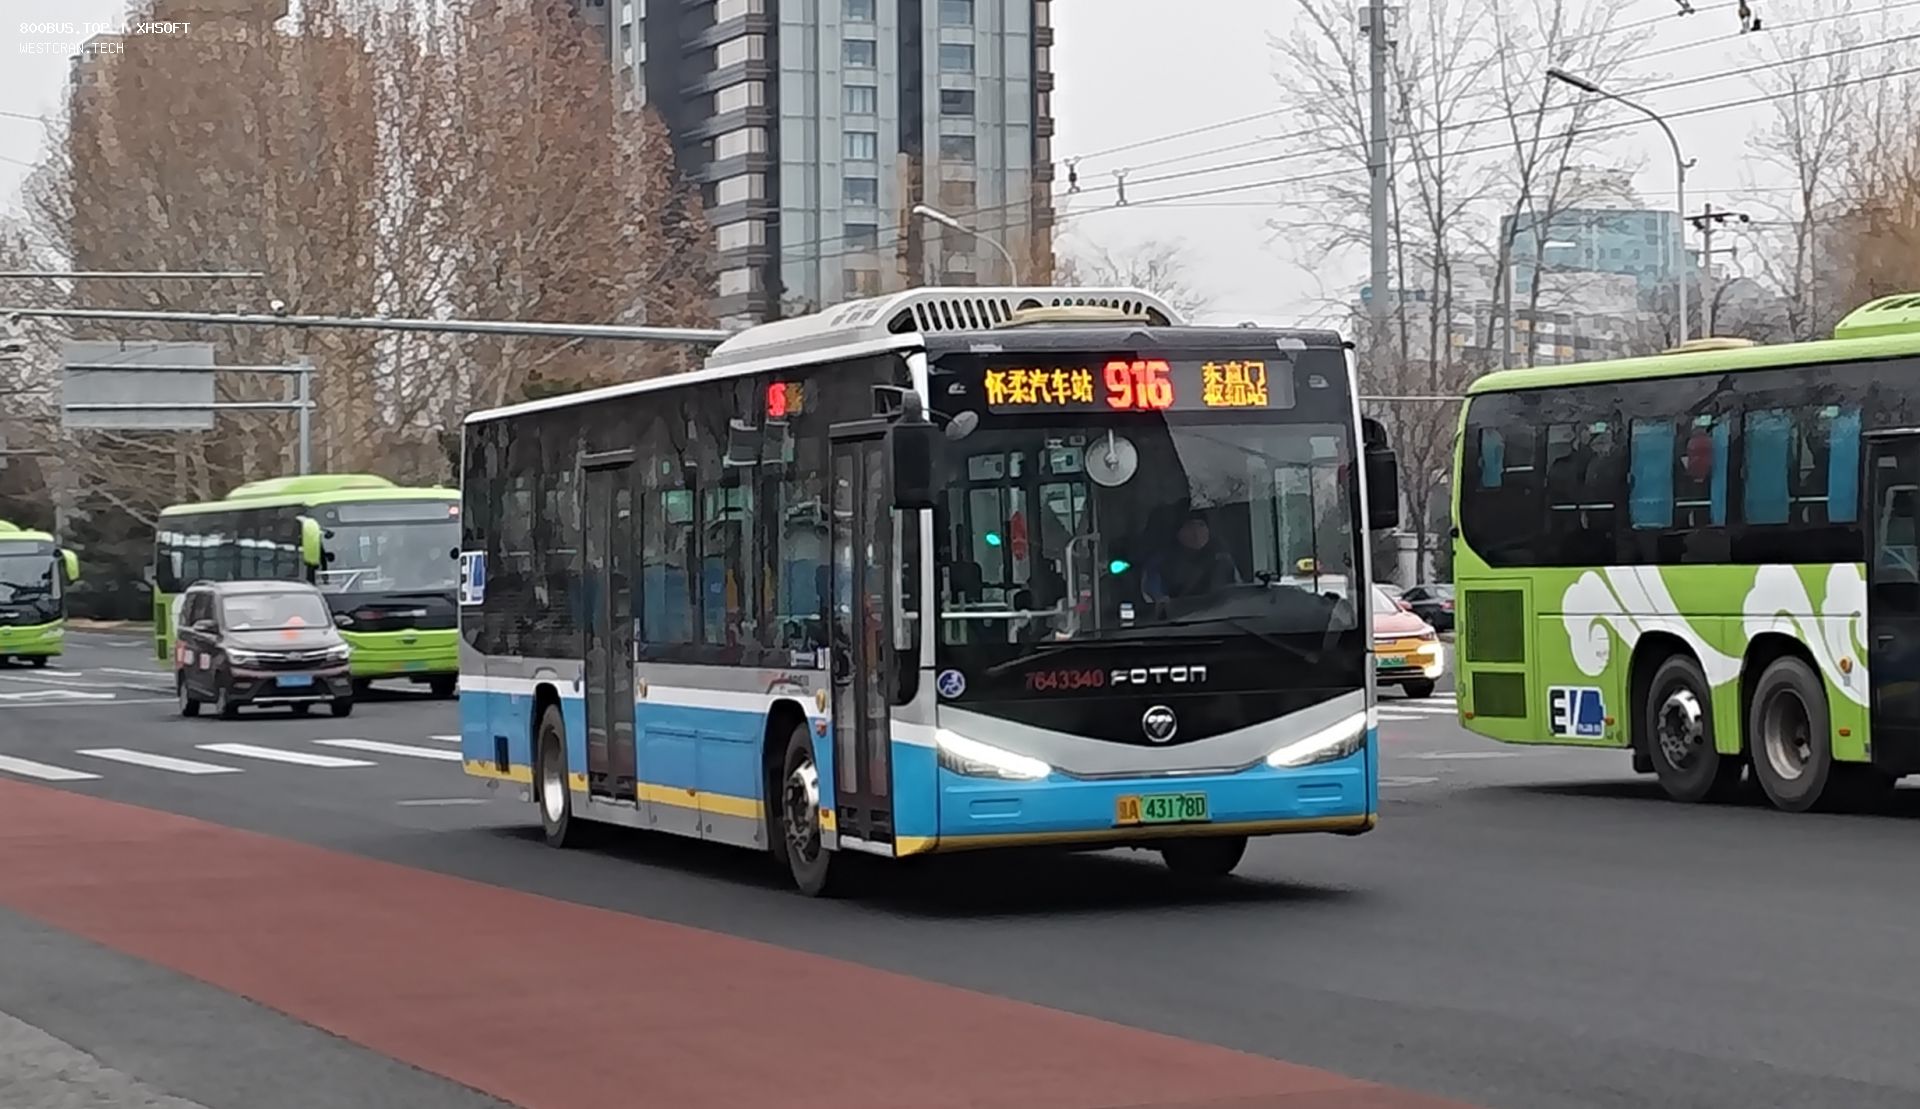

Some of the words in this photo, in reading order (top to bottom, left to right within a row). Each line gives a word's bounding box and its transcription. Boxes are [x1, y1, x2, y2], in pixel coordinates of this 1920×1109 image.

[1201, 360, 1266, 384] 东直门
[984, 368, 1094, 405] 怀柔汽车站
[1104, 360, 1174, 410] 916
[1025, 670, 1104, 690] 7643340
[1110, 665, 1206, 687] FOTON
[1146, 796, 1206, 819] 43178D
